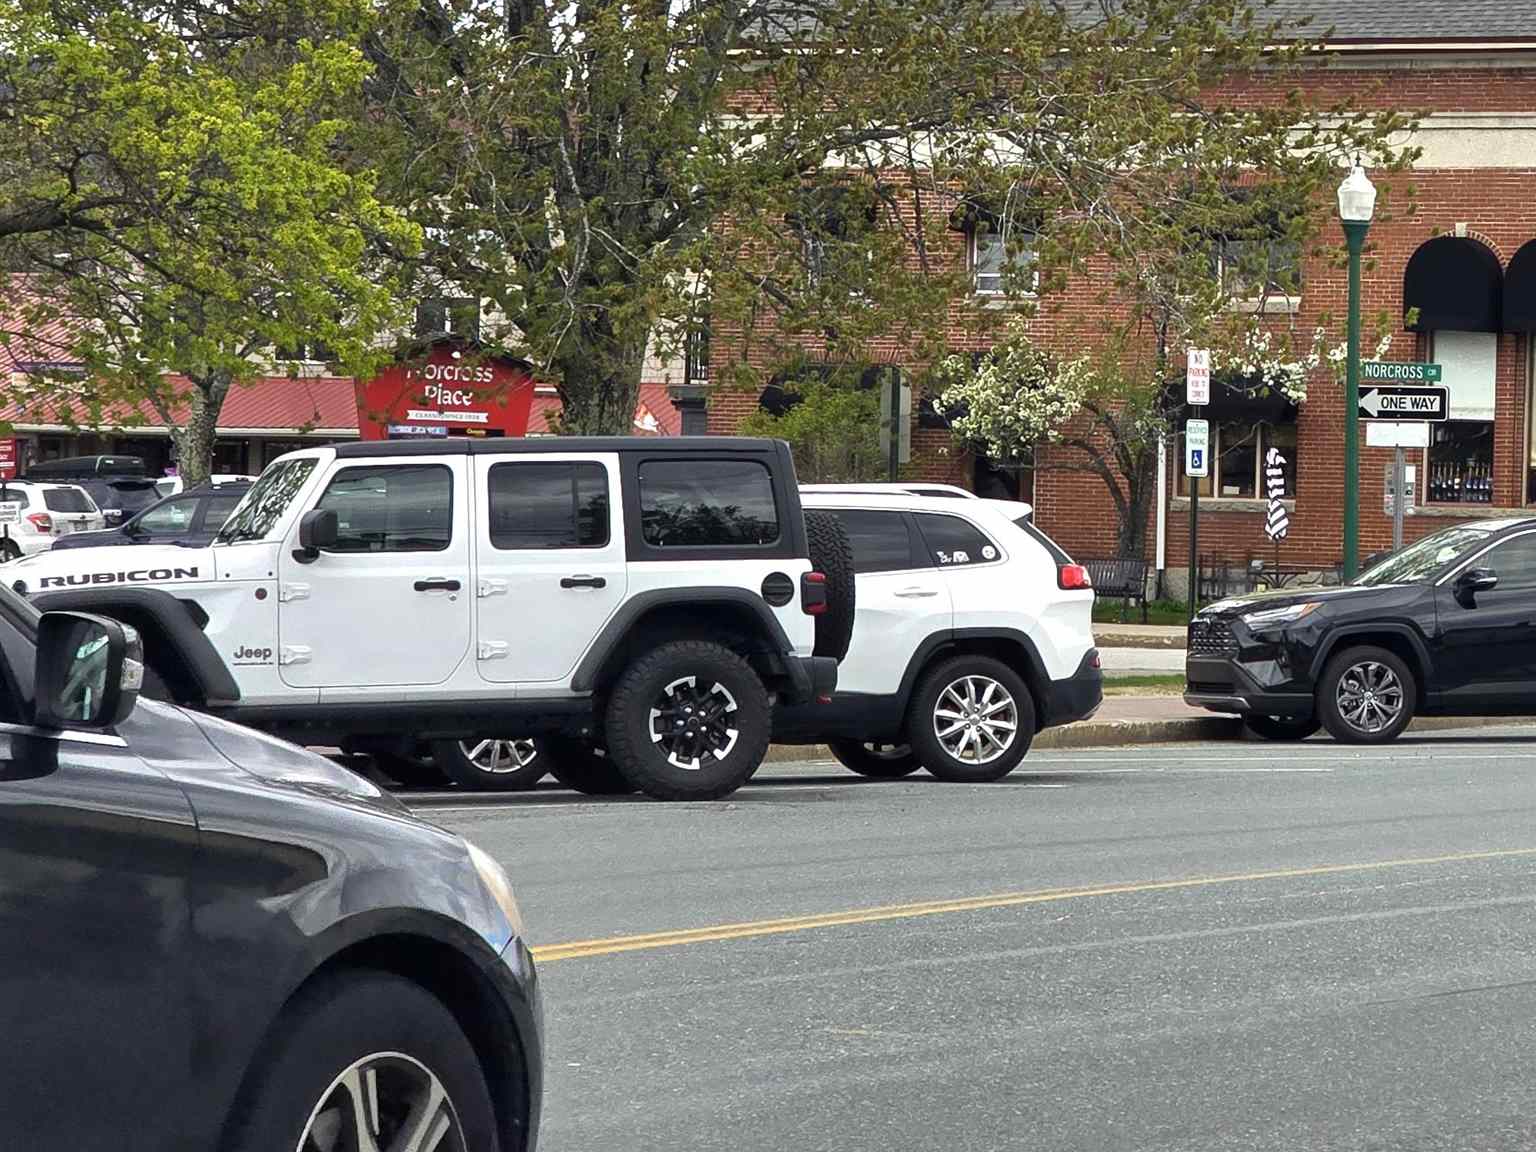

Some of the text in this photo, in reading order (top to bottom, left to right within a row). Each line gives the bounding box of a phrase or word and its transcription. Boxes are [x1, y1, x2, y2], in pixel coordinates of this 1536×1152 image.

[406, 364, 494, 383] orcross
[1365, 364, 1423, 379] NORCROSS
[1381, 396, 1437, 410] ONE WAY
[40, 567, 198, 588] RUBICON
[233, 646, 273, 660] Jeep
